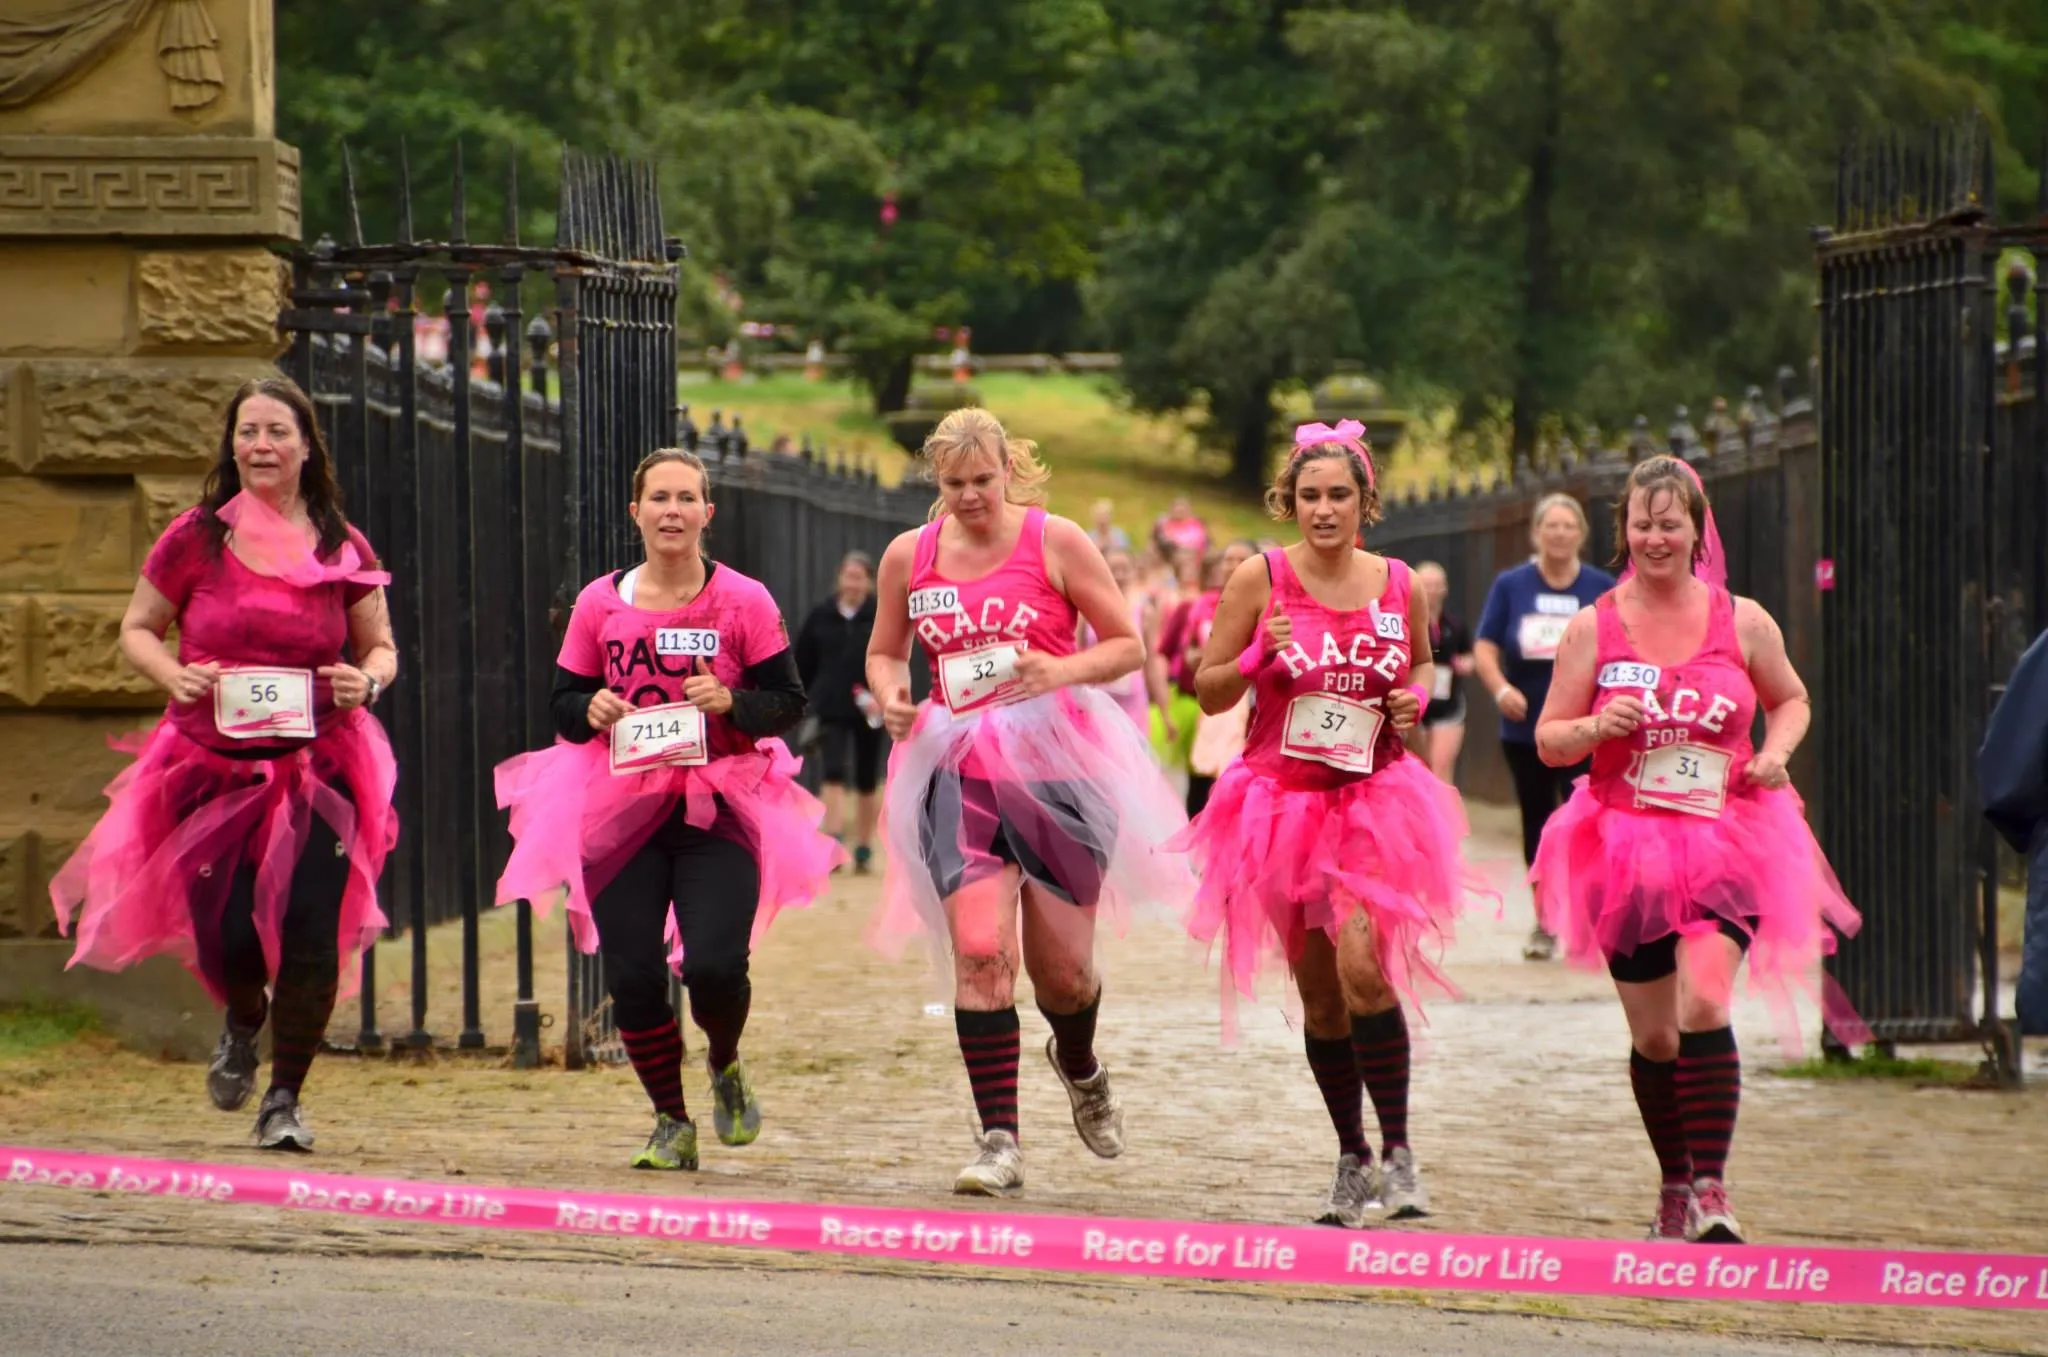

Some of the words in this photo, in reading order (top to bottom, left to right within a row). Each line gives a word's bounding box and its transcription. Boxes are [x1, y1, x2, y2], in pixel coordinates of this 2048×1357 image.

[911, 591, 956, 614] 11:30
[657, 632, 717, 652] 11:30
[917, 597, 1038, 650] RACE
[605, 637, 714, 678] RAC
[971, 660, 998, 682] 32
[250, 684, 279, 704] 56
[1322, 671, 1366, 692] FOR
[1320, 710, 1348, 733] 37
[1642, 688, 1738, 734] ACE
[631, 719, 682, 742] 7114
[1645, 727, 1690, 748] FOR
[1675, 756, 1701, 780] 31
[8, 1158, 97, 1187] Race
[104, 1166, 162, 1192] for
[165, 1171, 235, 1201] Life
[284, 1181, 373, 1210] Race
[379, 1188, 434, 1215] for
[440, 1191, 507, 1220] Life
[556, 1202, 641, 1232] Race
[648, 1207, 701, 1236] for
[708, 1211, 773, 1241] Life
[820, 1217, 903, 1249] Race
[911, 1221, 964, 1252] for
[970, 1224, 1034, 1257] Life
[1083, 1230, 1167, 1264] Race
[1174, 1234, 1226, 1267] for
[1233, 1236, 1297, 1271] Life
[1346, 1241, 1430, 1276] Race
[1438, 1246, 1492, 1279] for
[1498, 1248, 1563, 1282] Life
[1612, 1253, 1697, 1287] Race
[1704, 1257, 1759, 1290] for
[1765, 1259, 1830, 1292] Life
[1880, 1262, 1967, 1297] Race
[1974, 1266, 2029, 1299] for
